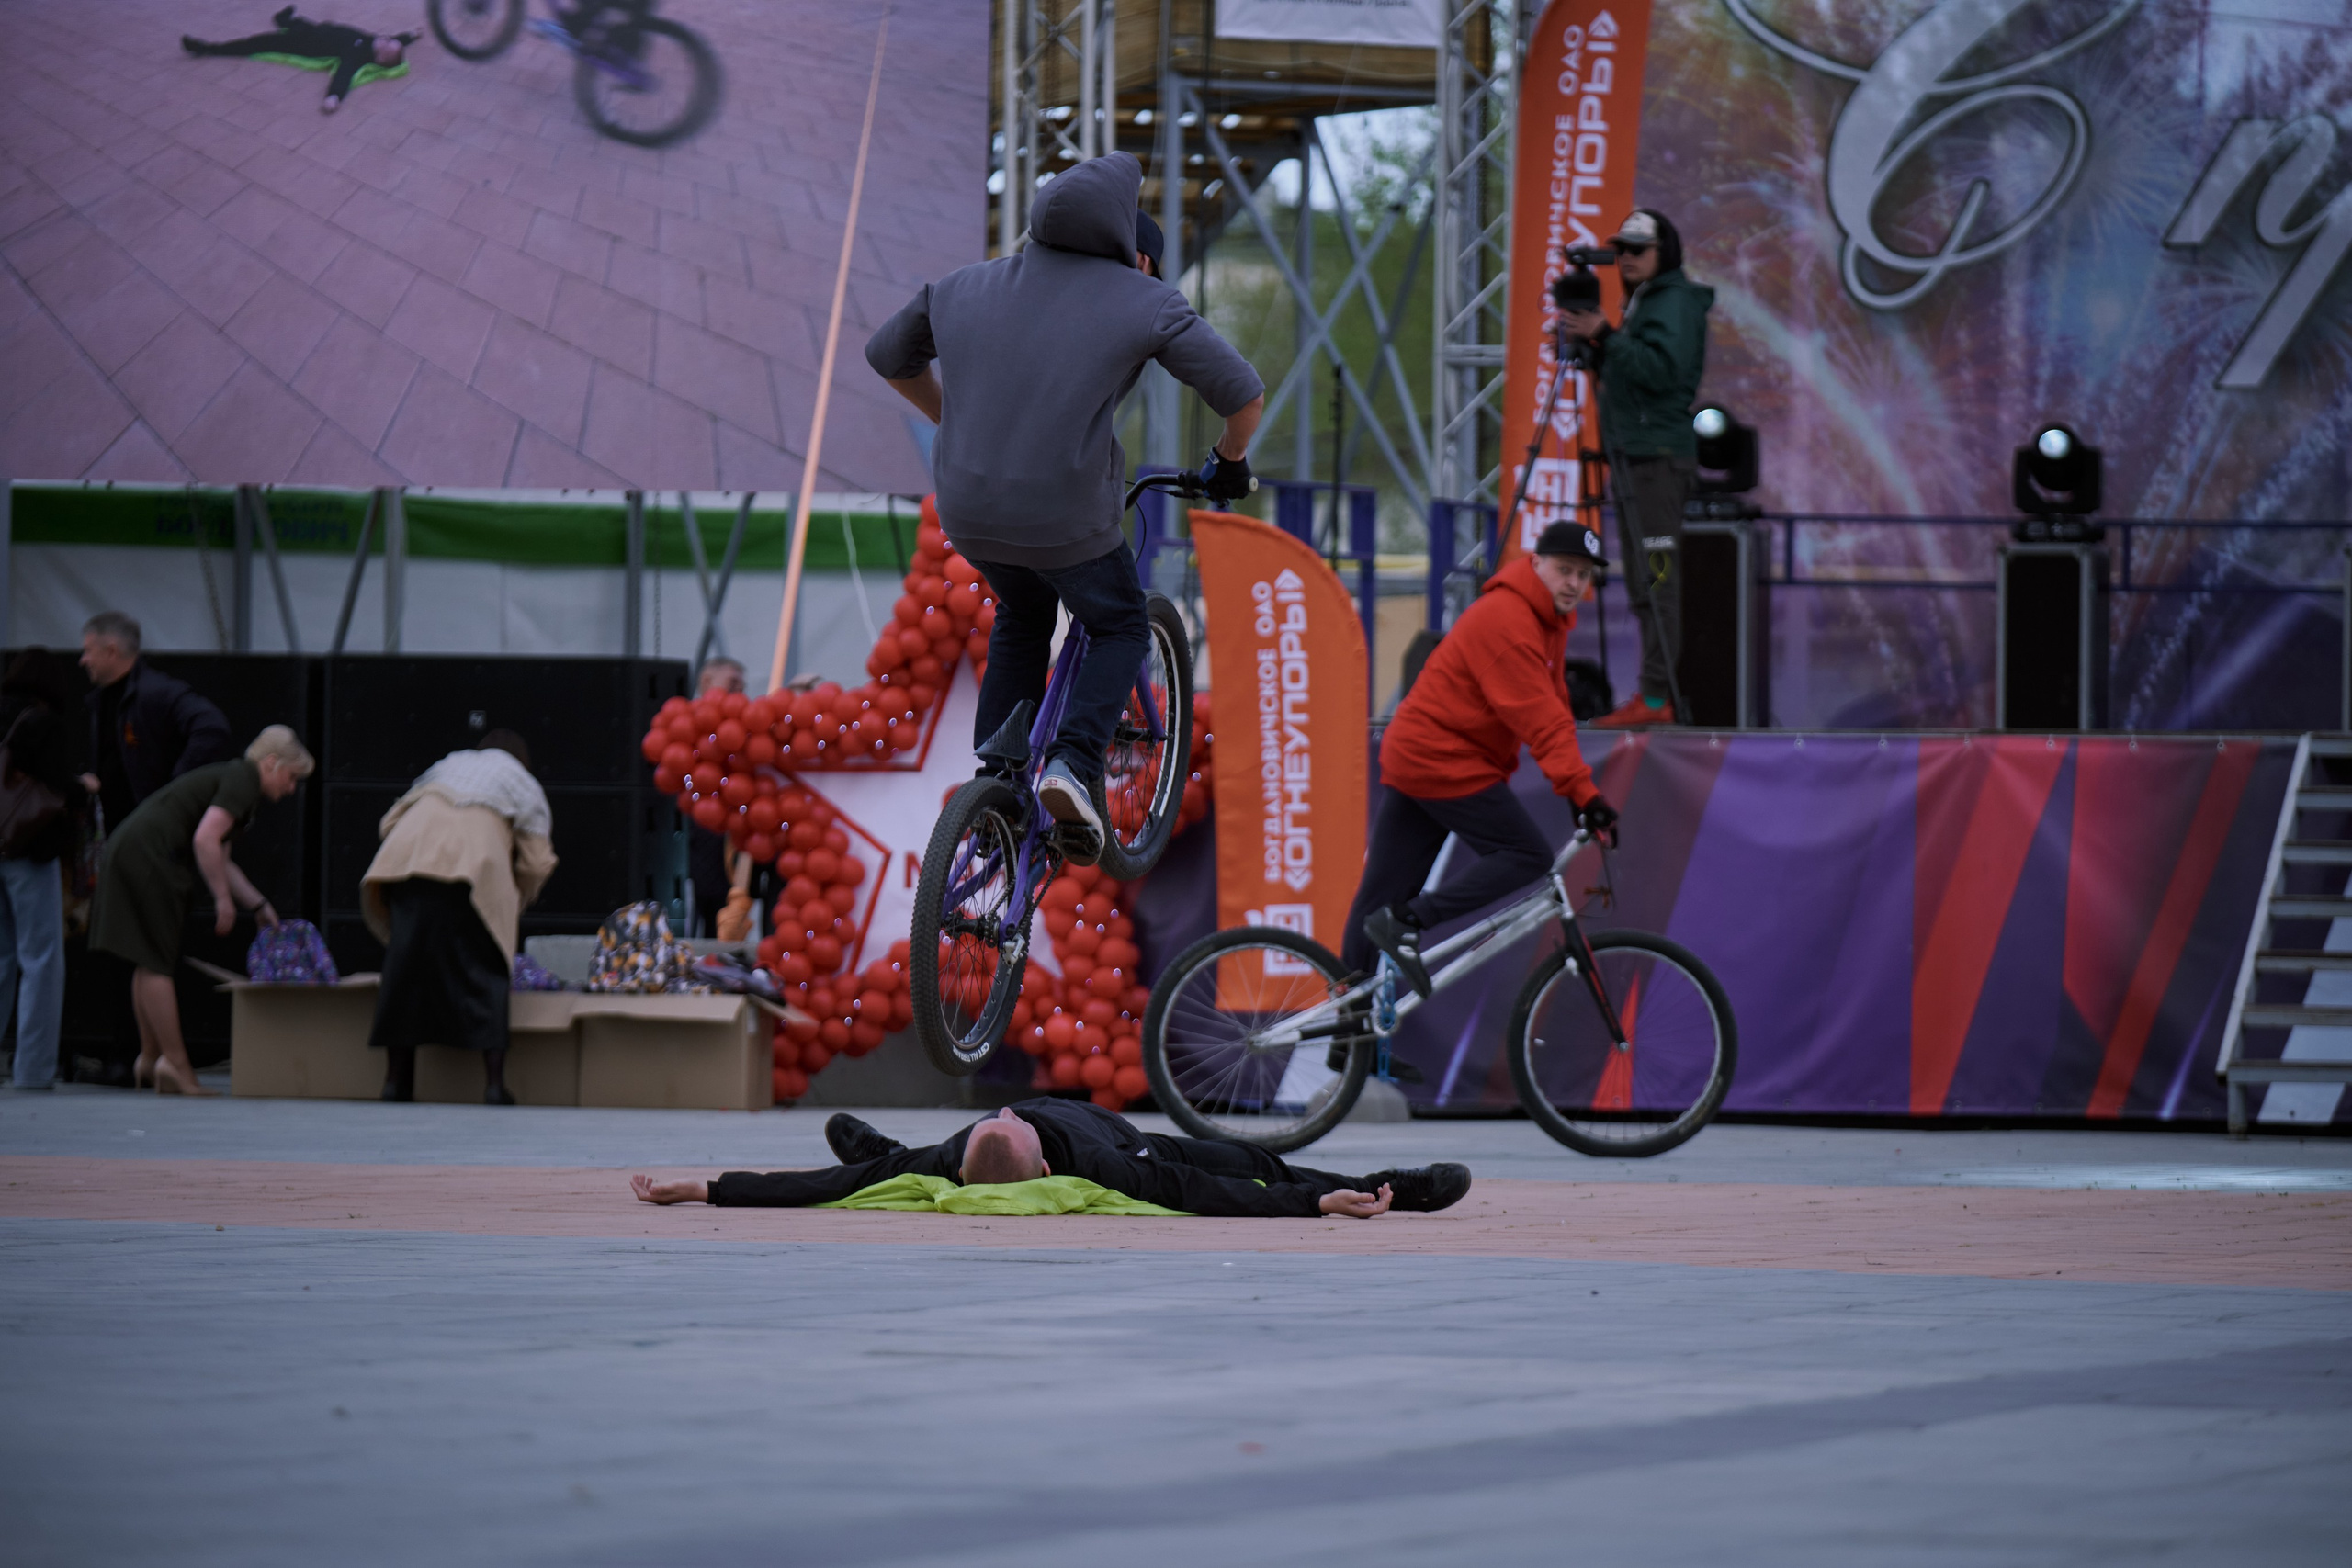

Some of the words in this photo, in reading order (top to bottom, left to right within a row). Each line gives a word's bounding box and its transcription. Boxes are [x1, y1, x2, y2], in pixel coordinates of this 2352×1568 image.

[1558, 24, 1585, 96] ОАО
[1251, 581, 1275, 637] ОАО
[1257, 648, 1282, 882] БОГДАНОВИЧСКОЕ
[1274, 568, 1313, 892] «ОГНЕУПОРЫ»
[978, 1042, 989, 1058] CST
